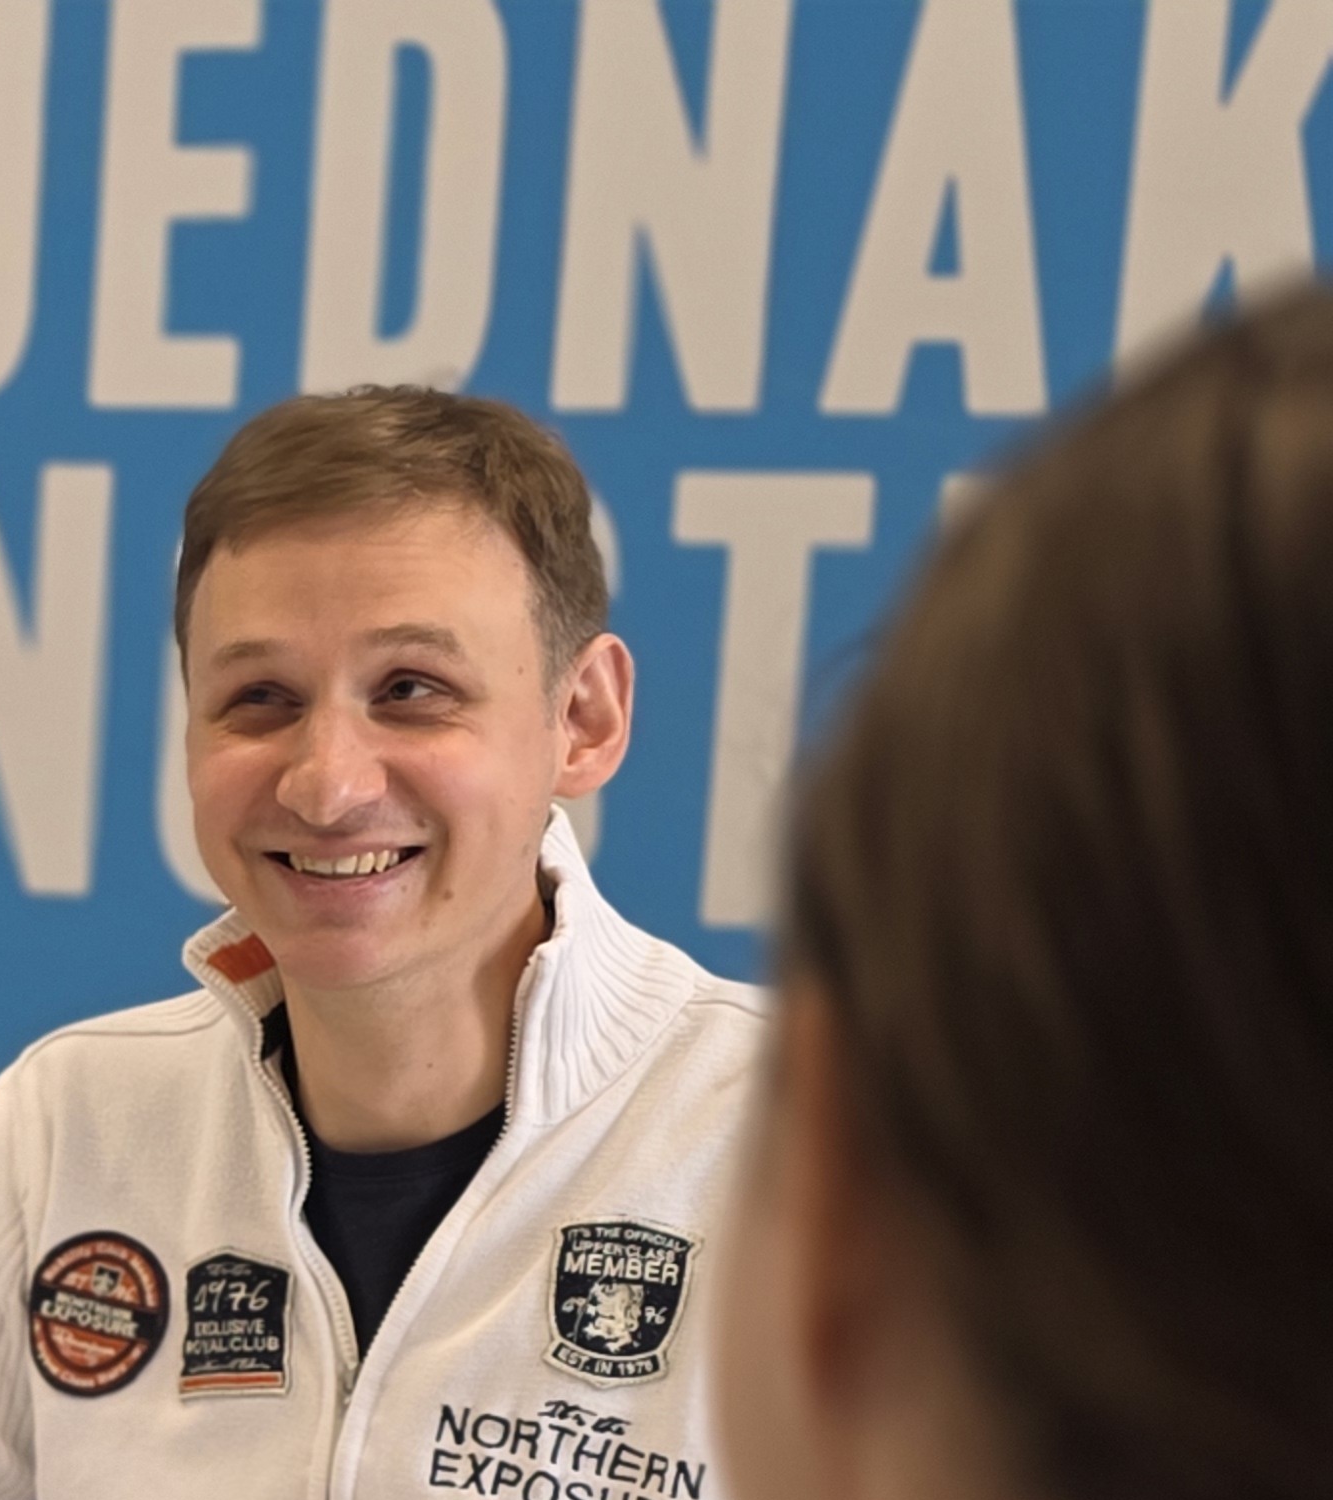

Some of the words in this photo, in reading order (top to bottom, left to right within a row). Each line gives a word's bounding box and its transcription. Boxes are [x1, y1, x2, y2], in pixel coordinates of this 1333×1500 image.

[595, 1227, 622, 1240] THE
[623, 1228, 688, 1253] OFFICIAL
[563, 1251, 681, 1287] MEMBER
[191, 1278, 272, 1315] 1976
[228, 1335, 281, 1354] CLUB
[556, 1347, 591, 1371] EST.
[594, 1360, 613, 1375] IN
[434, 1404, 707, 1500] NORTHERN
